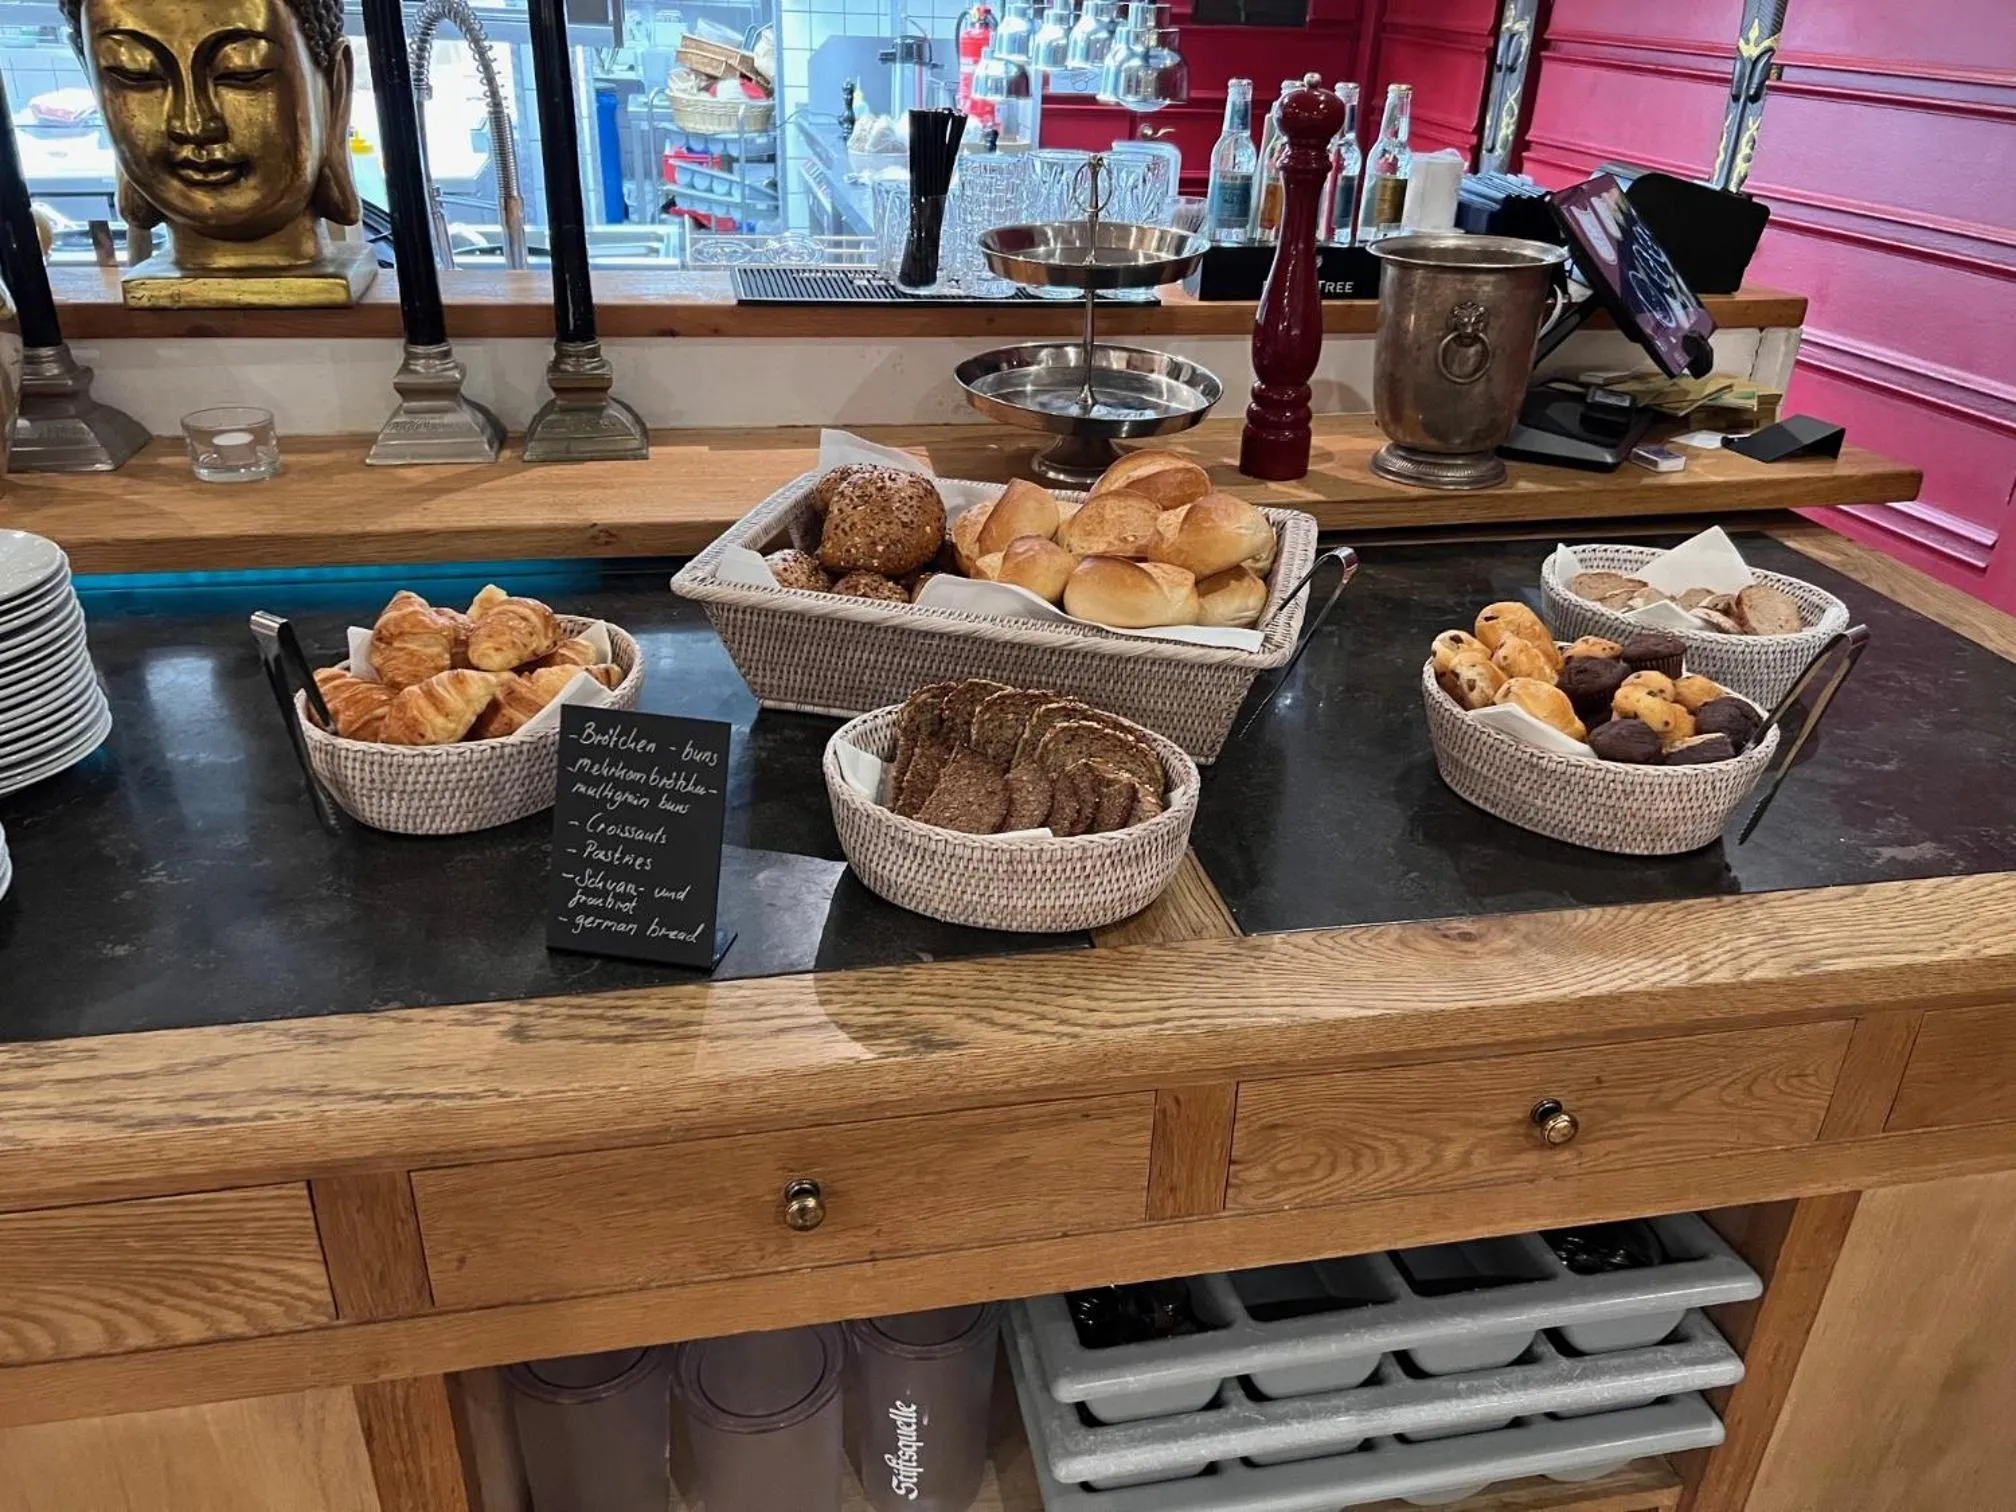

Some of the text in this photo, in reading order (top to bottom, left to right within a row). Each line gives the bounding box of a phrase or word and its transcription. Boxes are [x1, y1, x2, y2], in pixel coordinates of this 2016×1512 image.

[681, 740, 720, 767] buns
[658, 793, 691, 815] buns
[583, 839, 653, 872] Pastries
[654, 885, 692, 901] und
[646, 917, 705, 944] bread
[884, 1400, 924, 1500] Stiftsquelle
